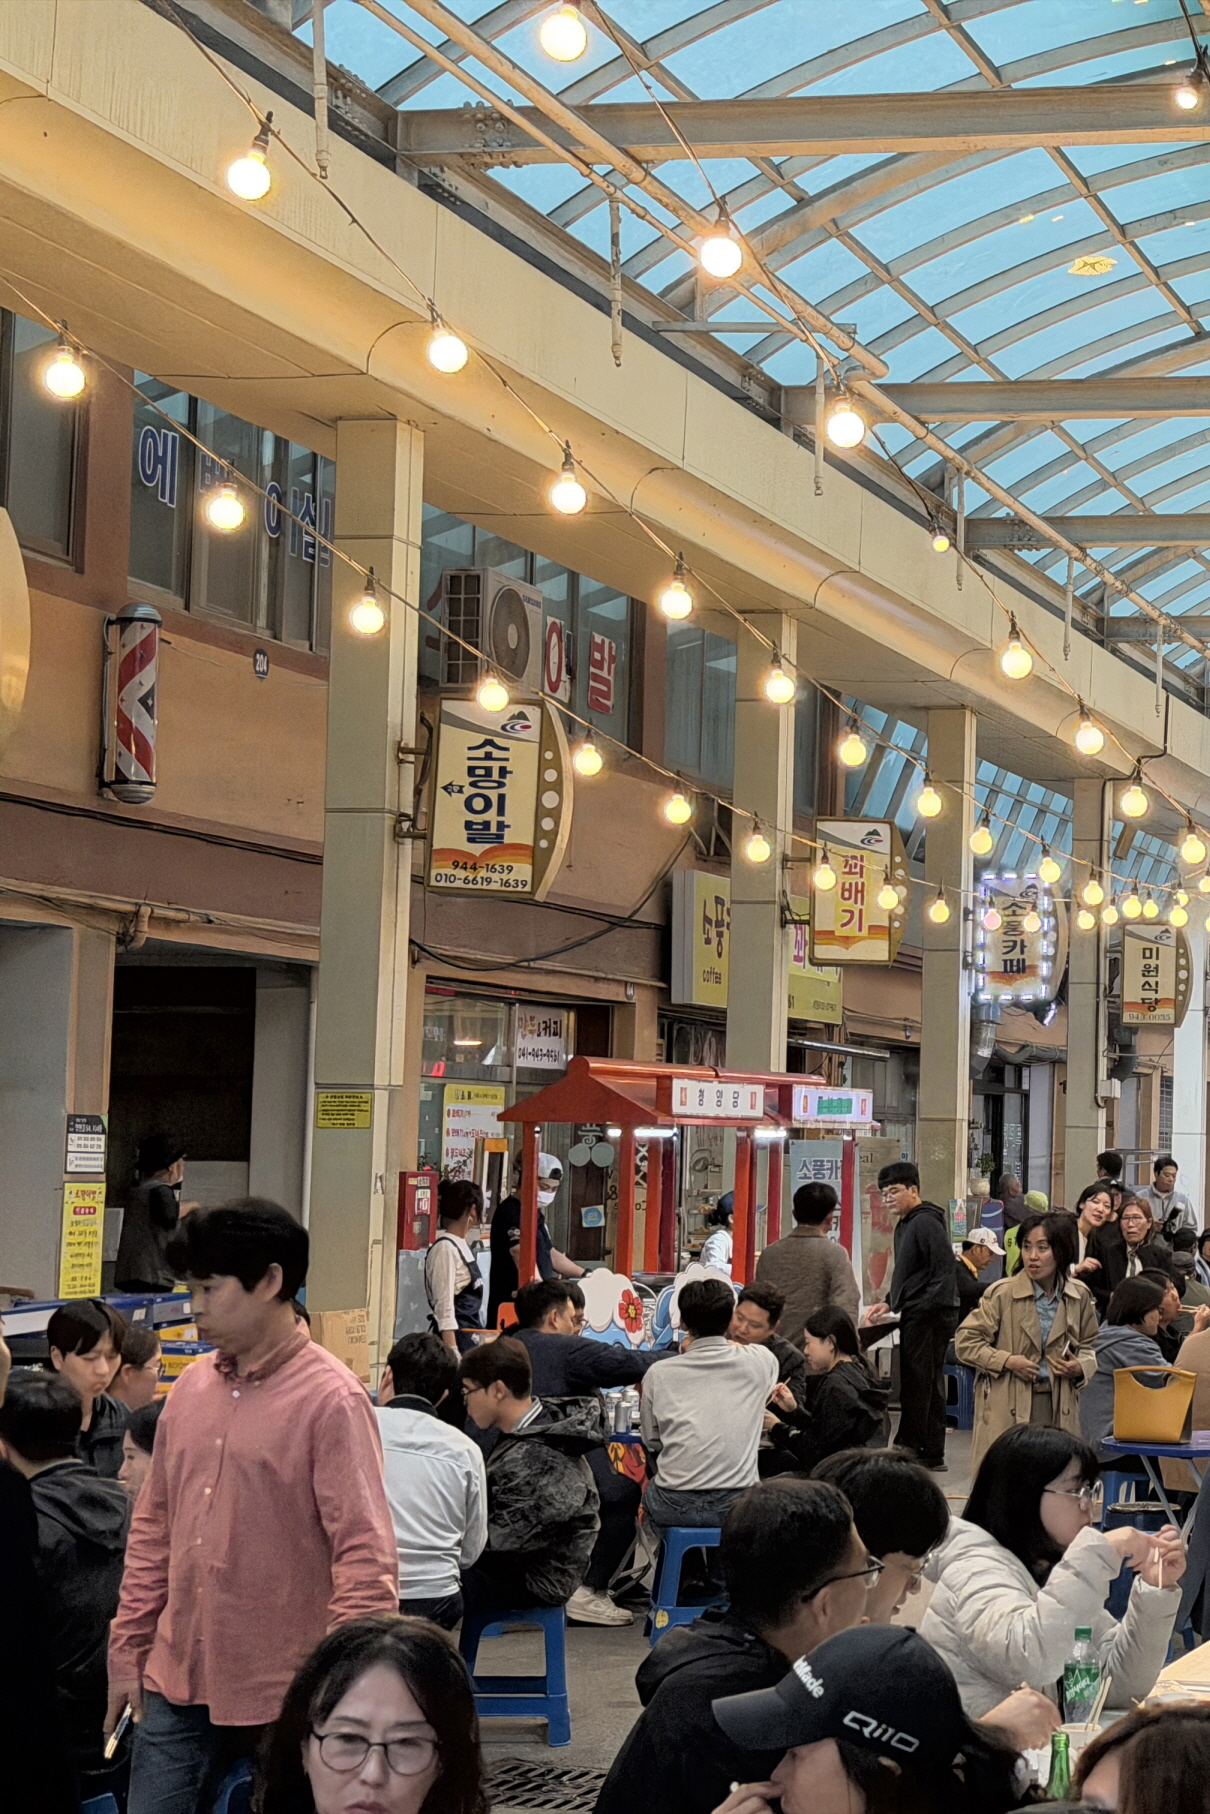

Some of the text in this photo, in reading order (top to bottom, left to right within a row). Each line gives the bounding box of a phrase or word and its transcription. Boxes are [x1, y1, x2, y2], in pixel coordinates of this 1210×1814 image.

[464, 738, 514, 844] 소망이발
[434, 873, 528, 889] 010-6619-1639
[451, 860, 514, 874] 944-1639
[703, 967, 722, 985] coffee
[1141, 946, 1161, 1012] 미원식당
[798, 1159, 842, 1180] 소풍카
[793, 1655, 825, 1698] Made
[843, 1711, 920, 1752] Qi10
